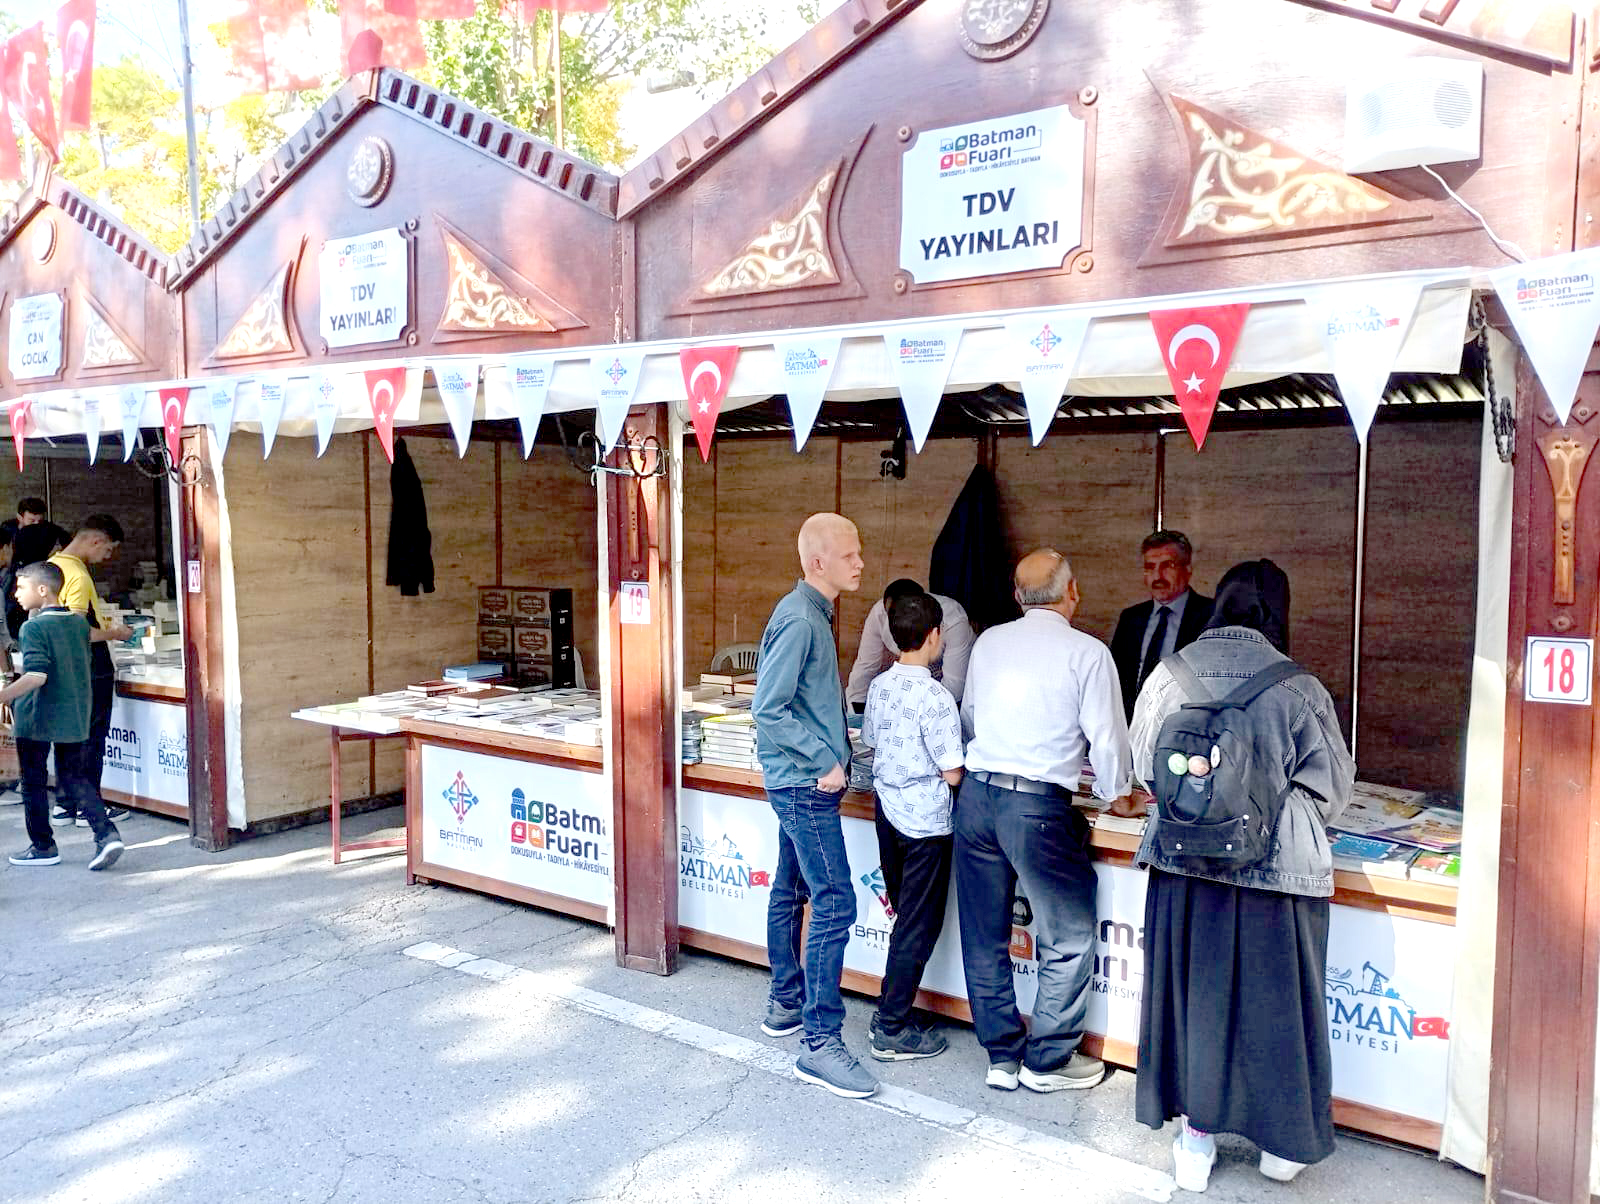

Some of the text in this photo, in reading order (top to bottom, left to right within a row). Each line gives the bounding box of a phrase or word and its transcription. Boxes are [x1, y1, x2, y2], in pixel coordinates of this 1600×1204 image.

[969, 125, 1036, 148] Batman
[969, 146, 1011, 165] Fuarı
[962, 187, 1016, 218] TDV
[919, 220, 1059, 261] YAYINLARI
[1538, 273, 1589, 288] Batman
[350, 282, 376, 302] TDV
[330, 306, 397, 331] YAYINLARI
[1327, 319, 1387, 336] BATMAN
[913, 339, 944, 348] Batman
[785, 359, 820, 371] BATMAN
[629, 588, 643, 616] 19
[1543, 647, 1575, 694] 18
[439, 829, 483, 848] BATMAN
[545, 829, 599, 860] Fuarı
[682, 878, 744, 900] BELEDİYESİ
